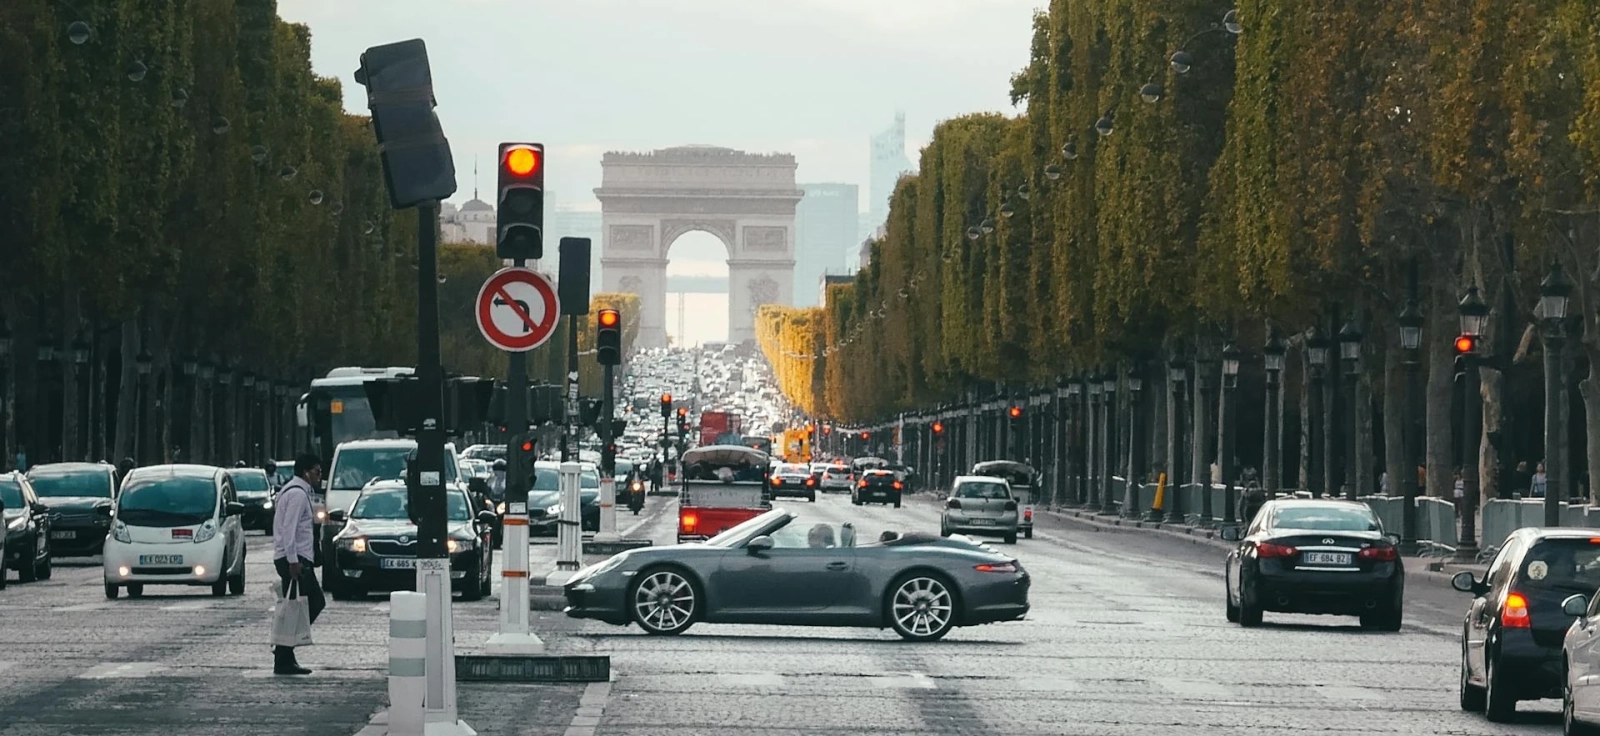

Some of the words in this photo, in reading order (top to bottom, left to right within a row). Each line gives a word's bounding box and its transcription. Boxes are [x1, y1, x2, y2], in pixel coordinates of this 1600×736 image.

[1309, 553, 1318, 562] EF
[1321, 554, 1334, 563] 684
[1337, 554, 1346, 563] BZ
